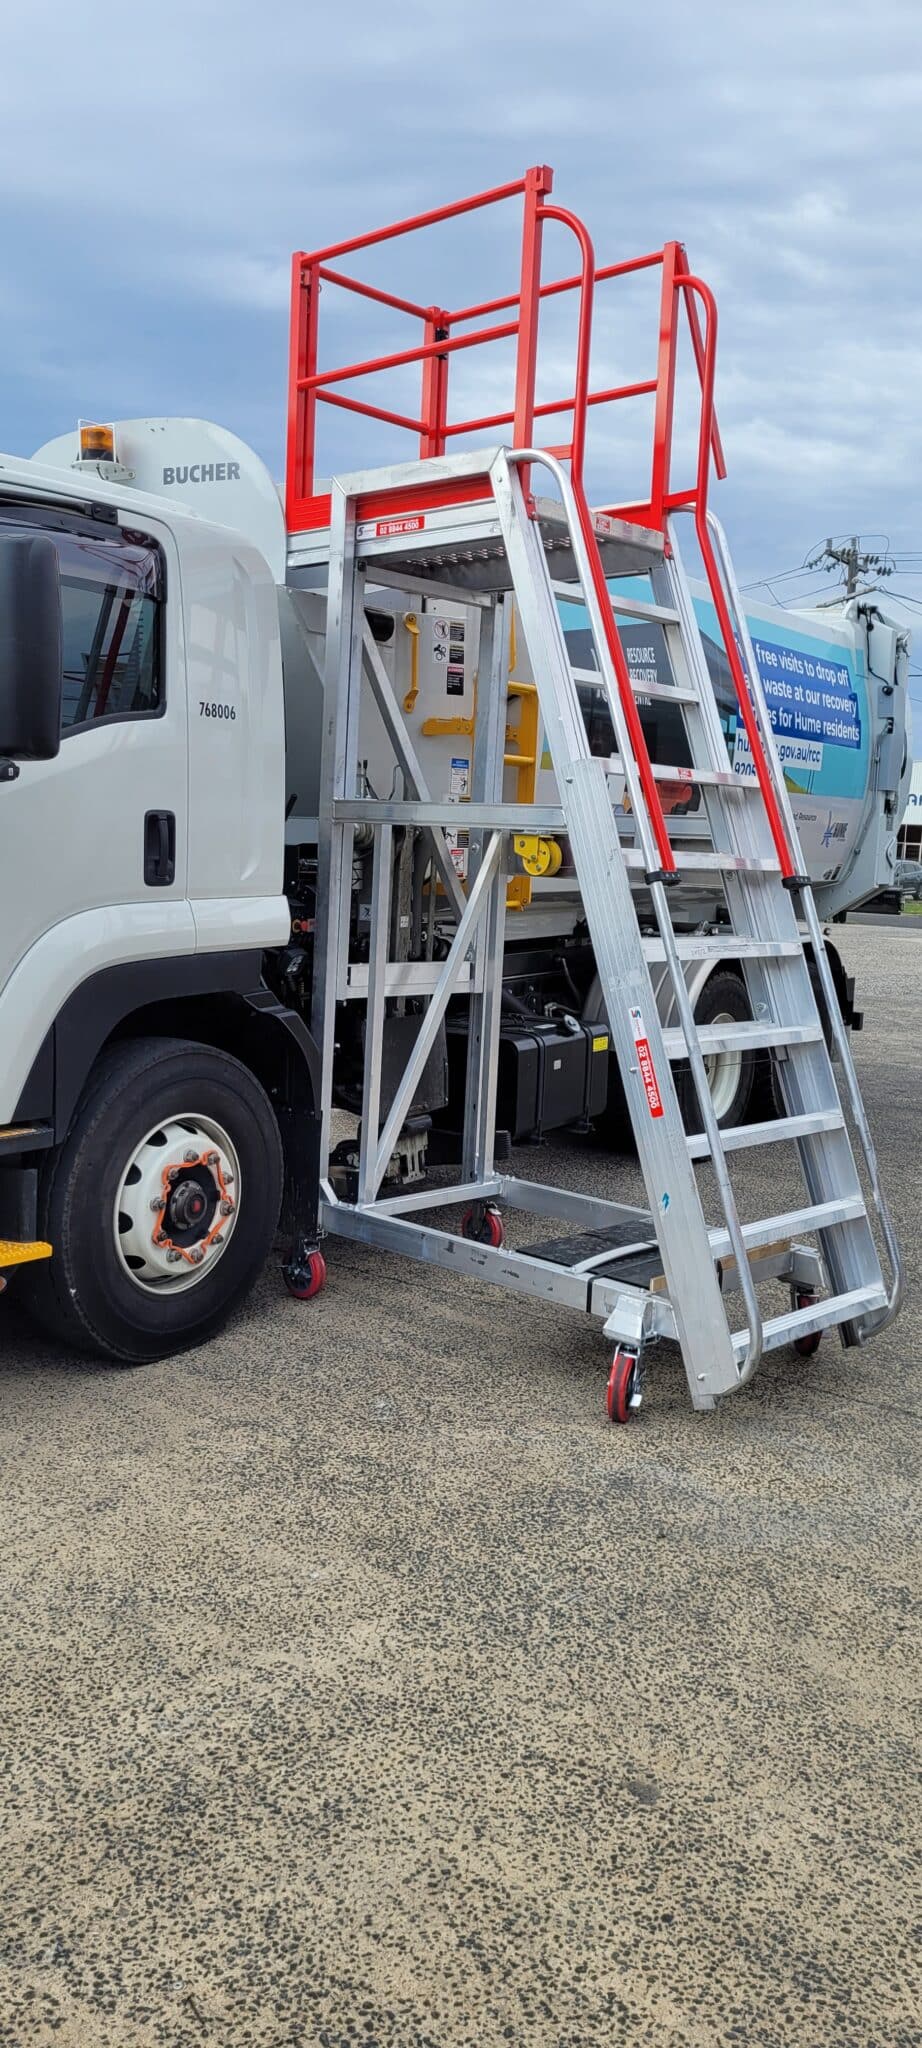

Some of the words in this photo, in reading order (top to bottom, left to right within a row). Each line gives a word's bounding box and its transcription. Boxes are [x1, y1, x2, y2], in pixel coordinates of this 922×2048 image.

[163, 462, 240, 485] BUCHER
[379, 526, 387, 535] 02
[404, 521, 419, 531] 4500
[627, 647, 656, 663] RESOURCE
[756, 643, 778, 667] free
[778, 651, 804, 674] visits
[804, 659, 815, 677] to
[816, 661, 837, 687] drop
[837, 669, 849, 687] off
[762, 678, 793, 699] waste
[794, 685, 804, 702] at
[805, 689, 820, 706] our
[822, 694, 857, 718] recovery
[199, 701, 236, 720] 768006
[779, 707, 792, 729] for
[794, 711, 821, 734] Hume
[823, 718, 860, 741] residents
[639, 1046, 646, 1058] 02
[641, 1060, 652, 1083] 8844
[647, 1085, 658, 1109] 4500
